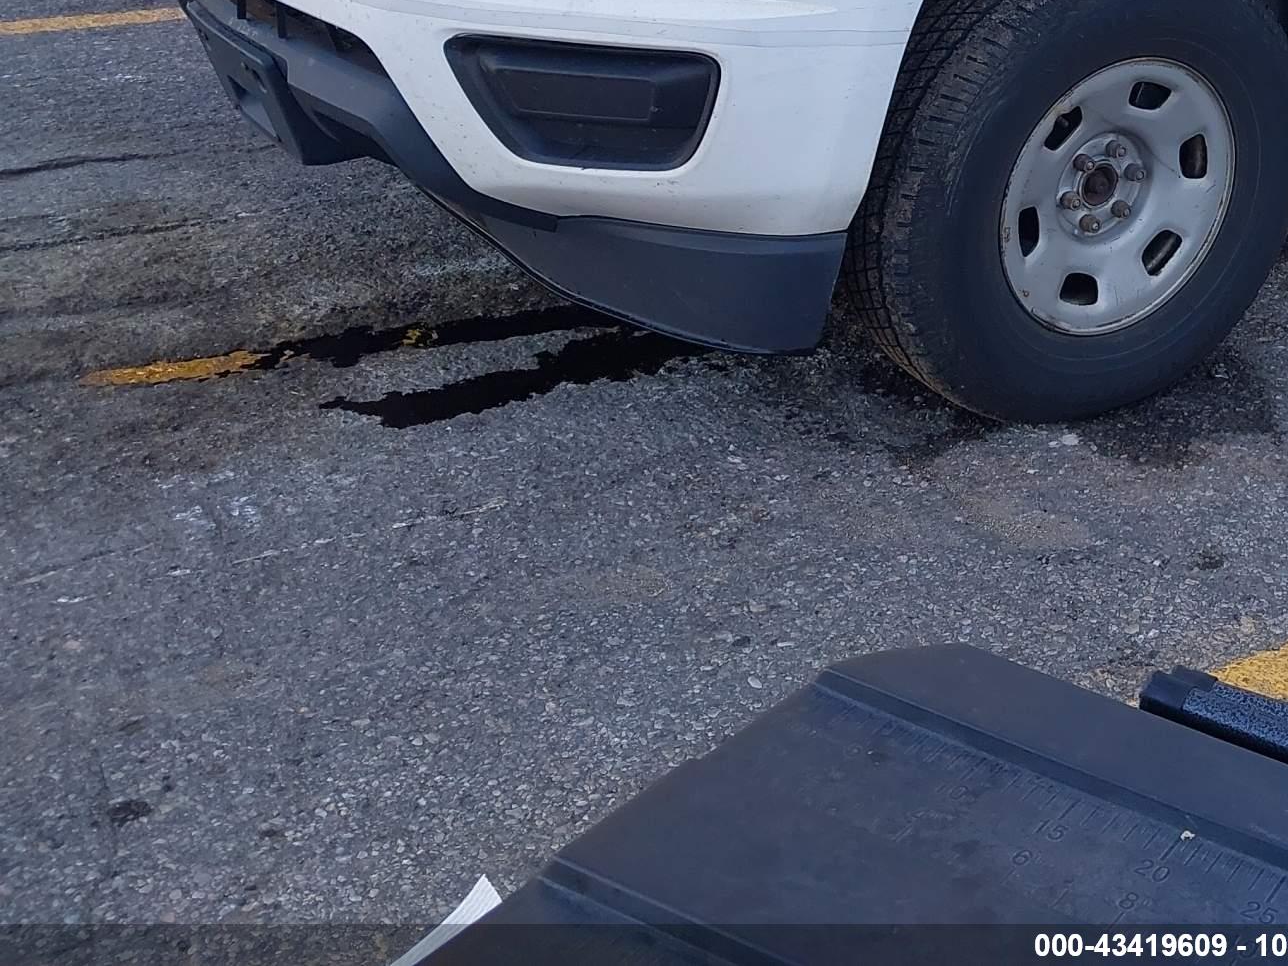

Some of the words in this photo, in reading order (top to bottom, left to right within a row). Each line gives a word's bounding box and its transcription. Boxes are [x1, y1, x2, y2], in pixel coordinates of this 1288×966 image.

[1034, 819, 1068, 841] 15
[1133, 859, 1171, 883] 20
[1240, 901, 1278, 924] 25
